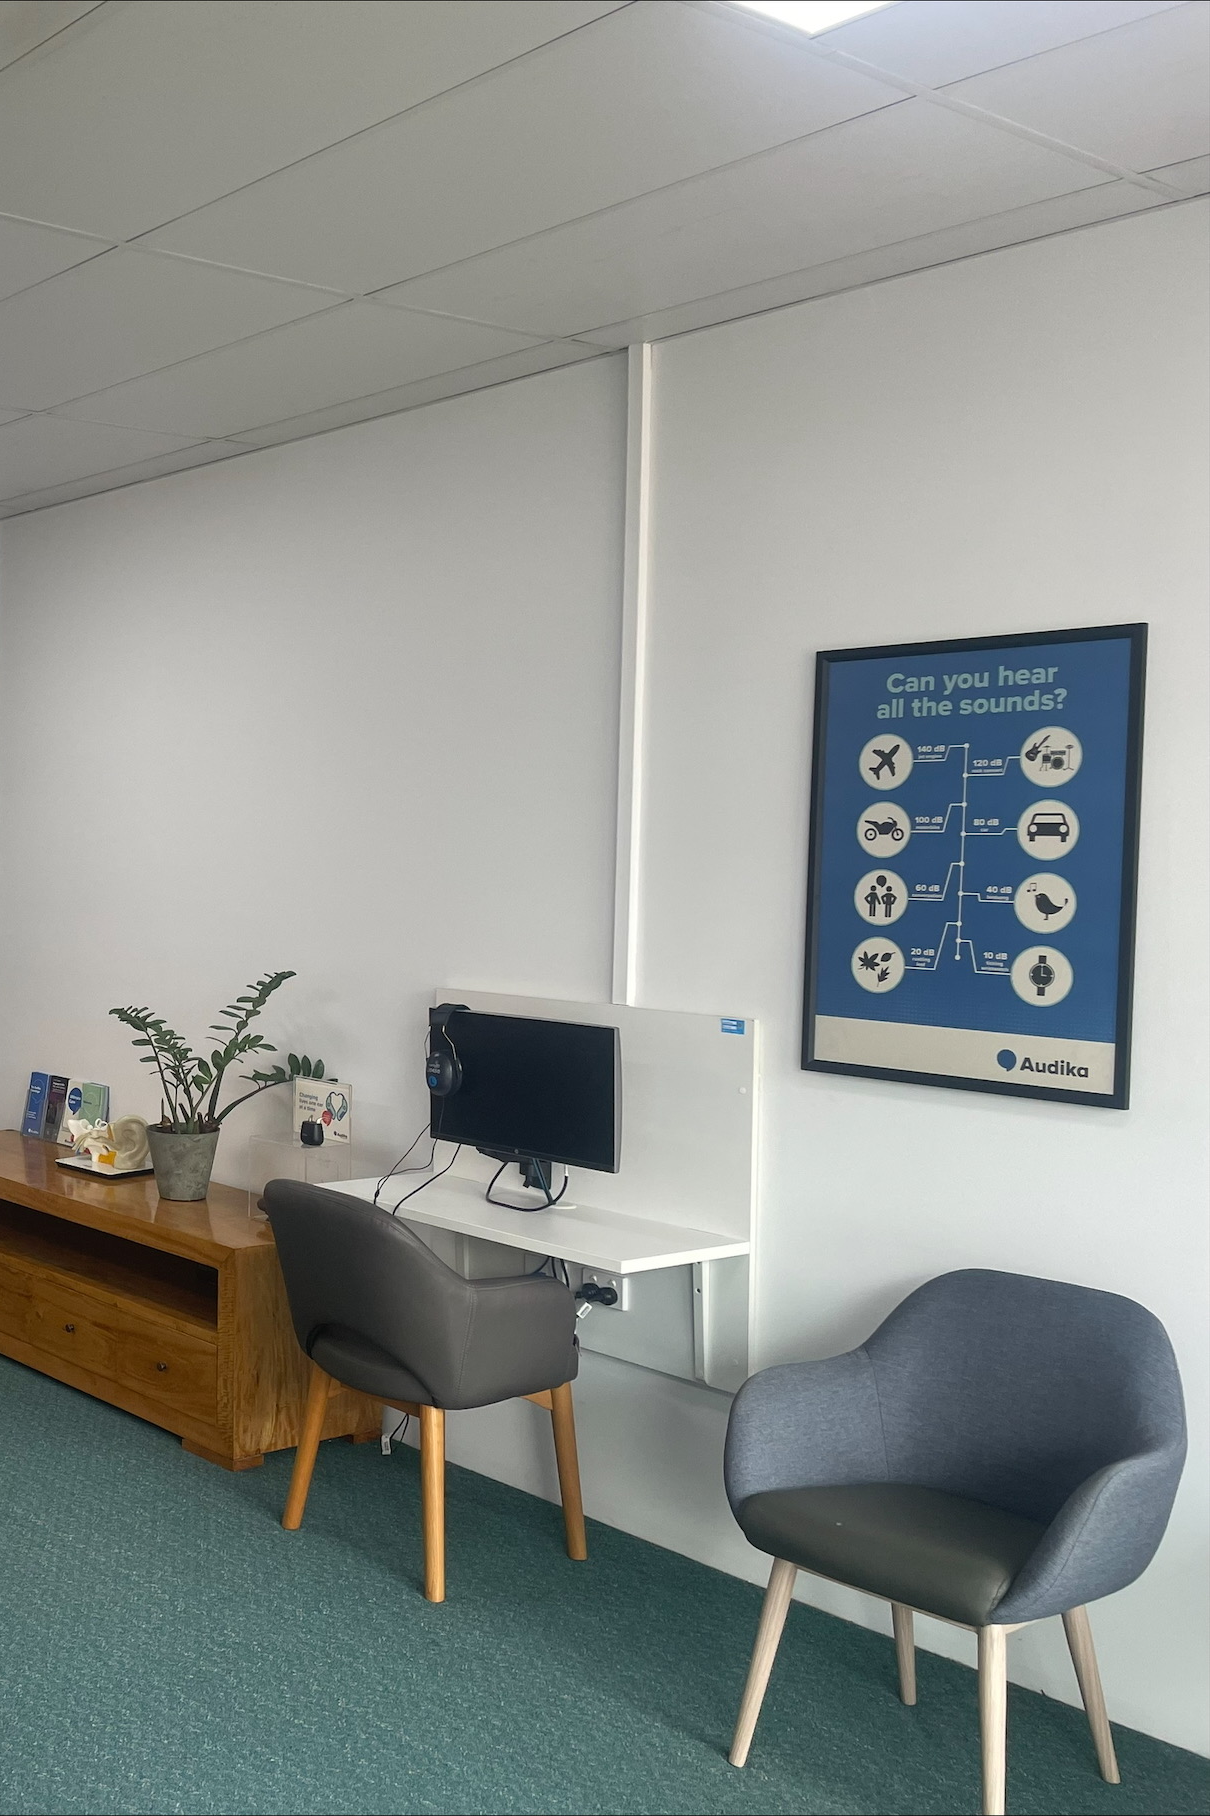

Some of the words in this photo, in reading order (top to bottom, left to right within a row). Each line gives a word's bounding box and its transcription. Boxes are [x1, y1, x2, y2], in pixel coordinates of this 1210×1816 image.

[886, 673, 935, 693] Can
[943, 671, 989, 695] you
[998, 666, 1058, 686] hear
[876, 699, 904, 719] all
[911, 697, 952, 717] the
[959, 688, 1067, 715] sounds?
[917, 745, 932, 753] 140
[972, 759, 989, 767] 120
[987, 818, 999, 826] dB
[915, 884, 927, 892] 60
[1020, 1057, 1089, 1078] Audika
[299, 1092, 319, 1101] Changing
